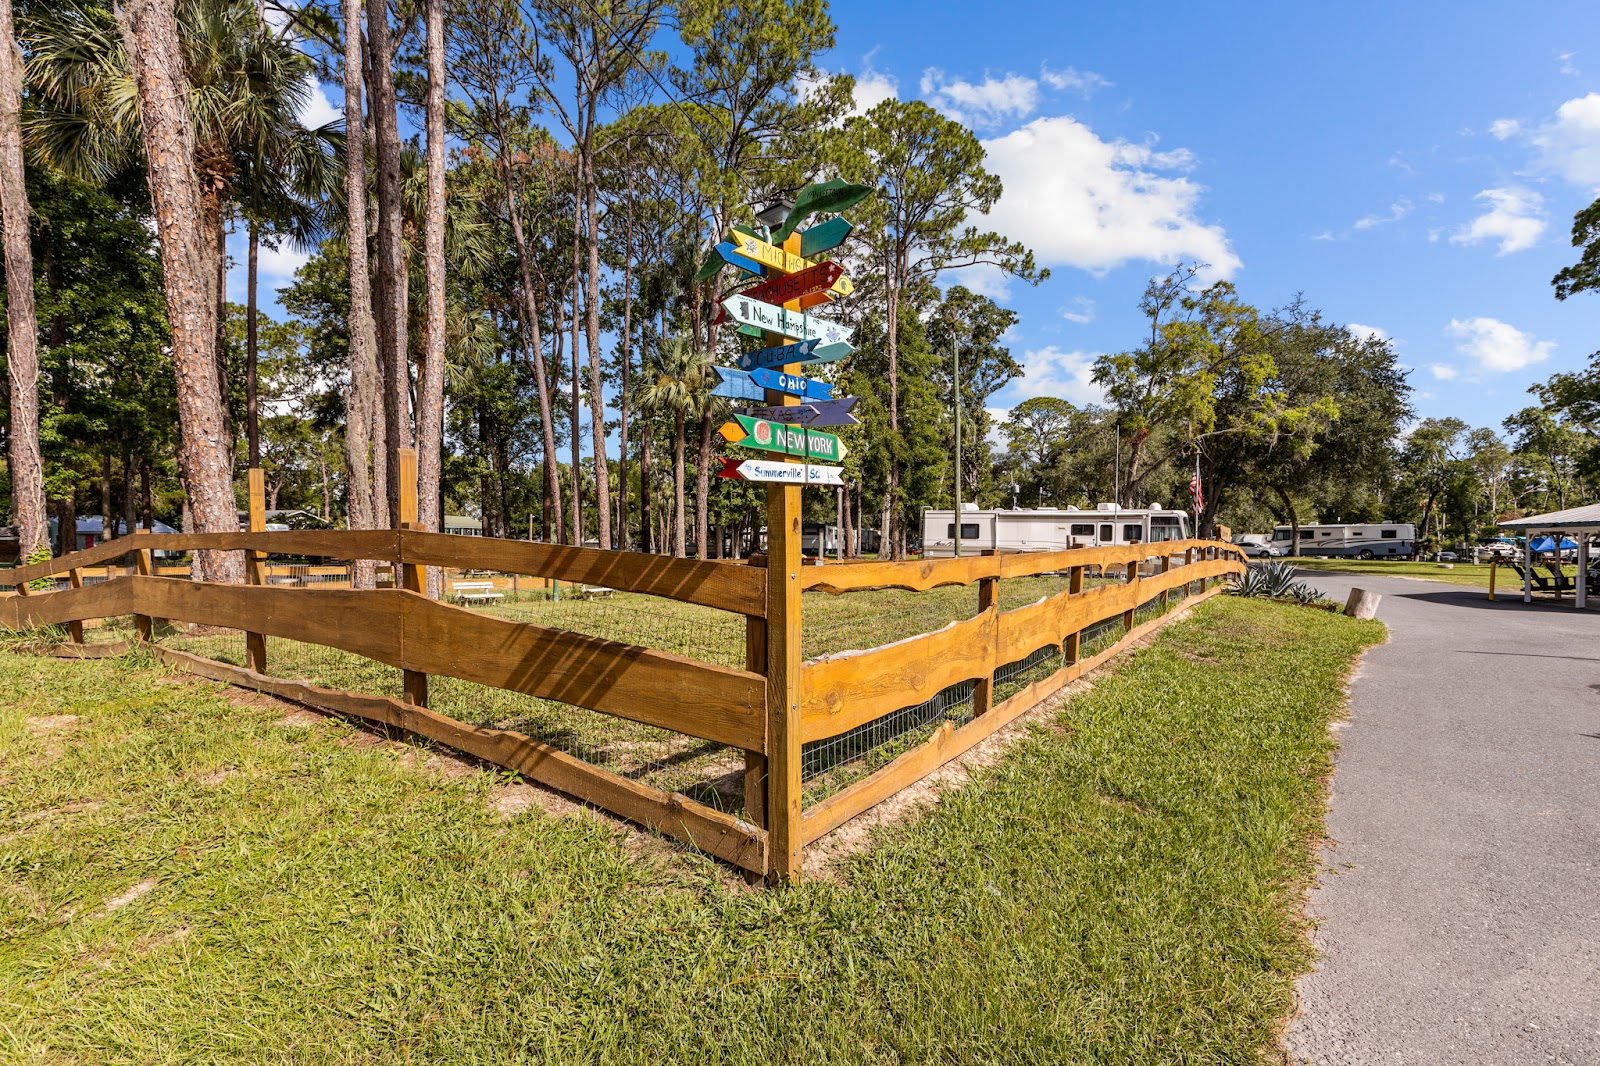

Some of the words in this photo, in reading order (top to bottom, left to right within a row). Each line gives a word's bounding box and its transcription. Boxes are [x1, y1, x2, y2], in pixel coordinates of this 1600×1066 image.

[763, 244, 812, 272] MICHIGA
[753, 306, 774, 326] New
[777, 313, 817, 338] Hampshire
[756, 345, 796, 366] CUBA
[754, 408, 792, 422] TEXAS
[776, 429, 806, 449] NEW
[807, 435, 833, 455] YORK
[754, 466, 802, 478] Summerville
